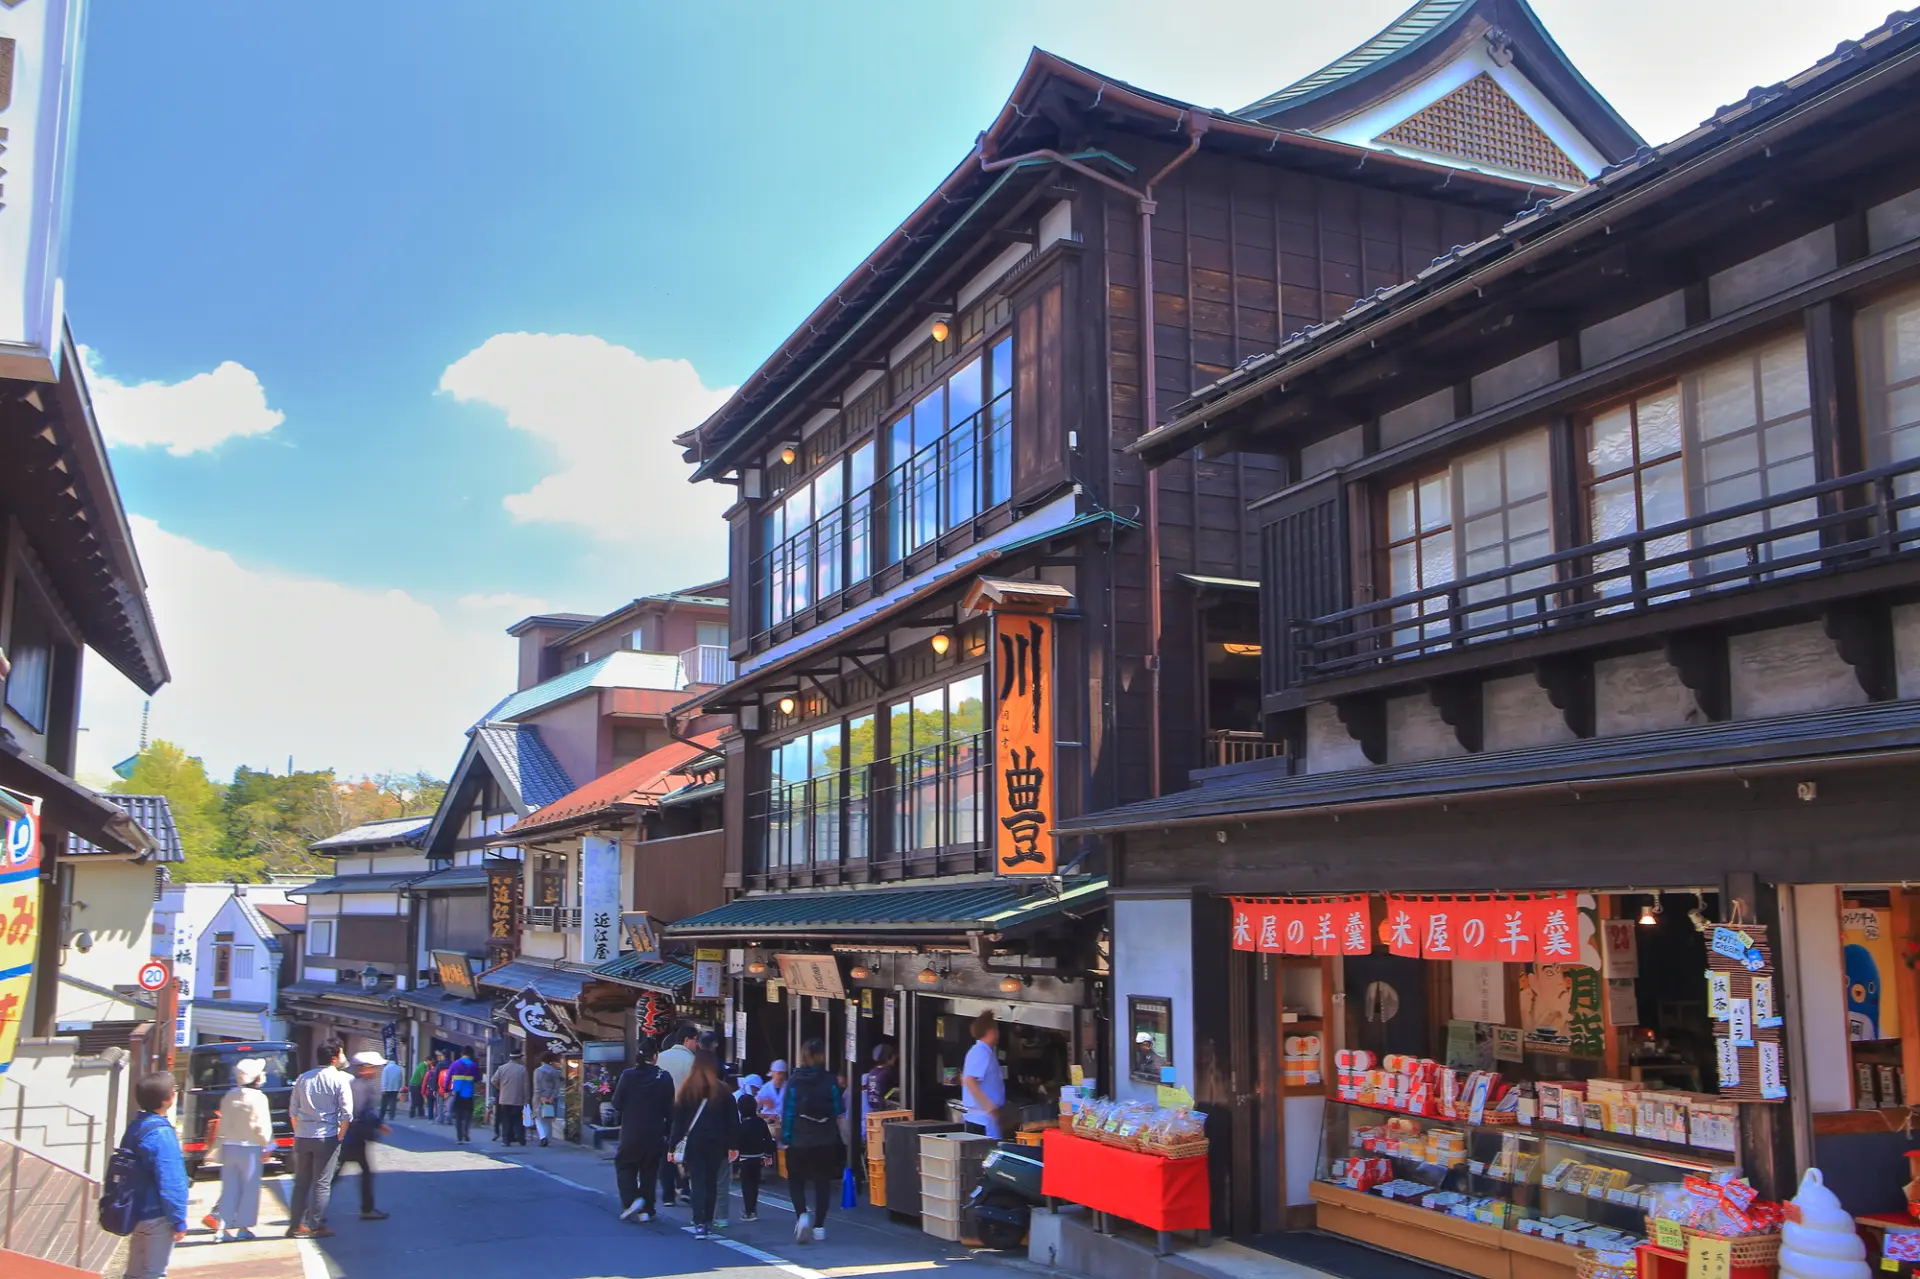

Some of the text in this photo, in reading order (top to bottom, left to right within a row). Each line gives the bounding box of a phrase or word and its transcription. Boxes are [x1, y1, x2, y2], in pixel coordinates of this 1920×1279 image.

[999, 620, 1047, 868] 川豊
[593, 912, 611, 960] 近江屋
[1233, 911, 1367, 951] 米屋の羊羹
[1391, 909, 1573, 957] 米屋の羊羹
[144, 970, 162, 983] 20
[1733, 1006, 1745, 1040] バニラ
